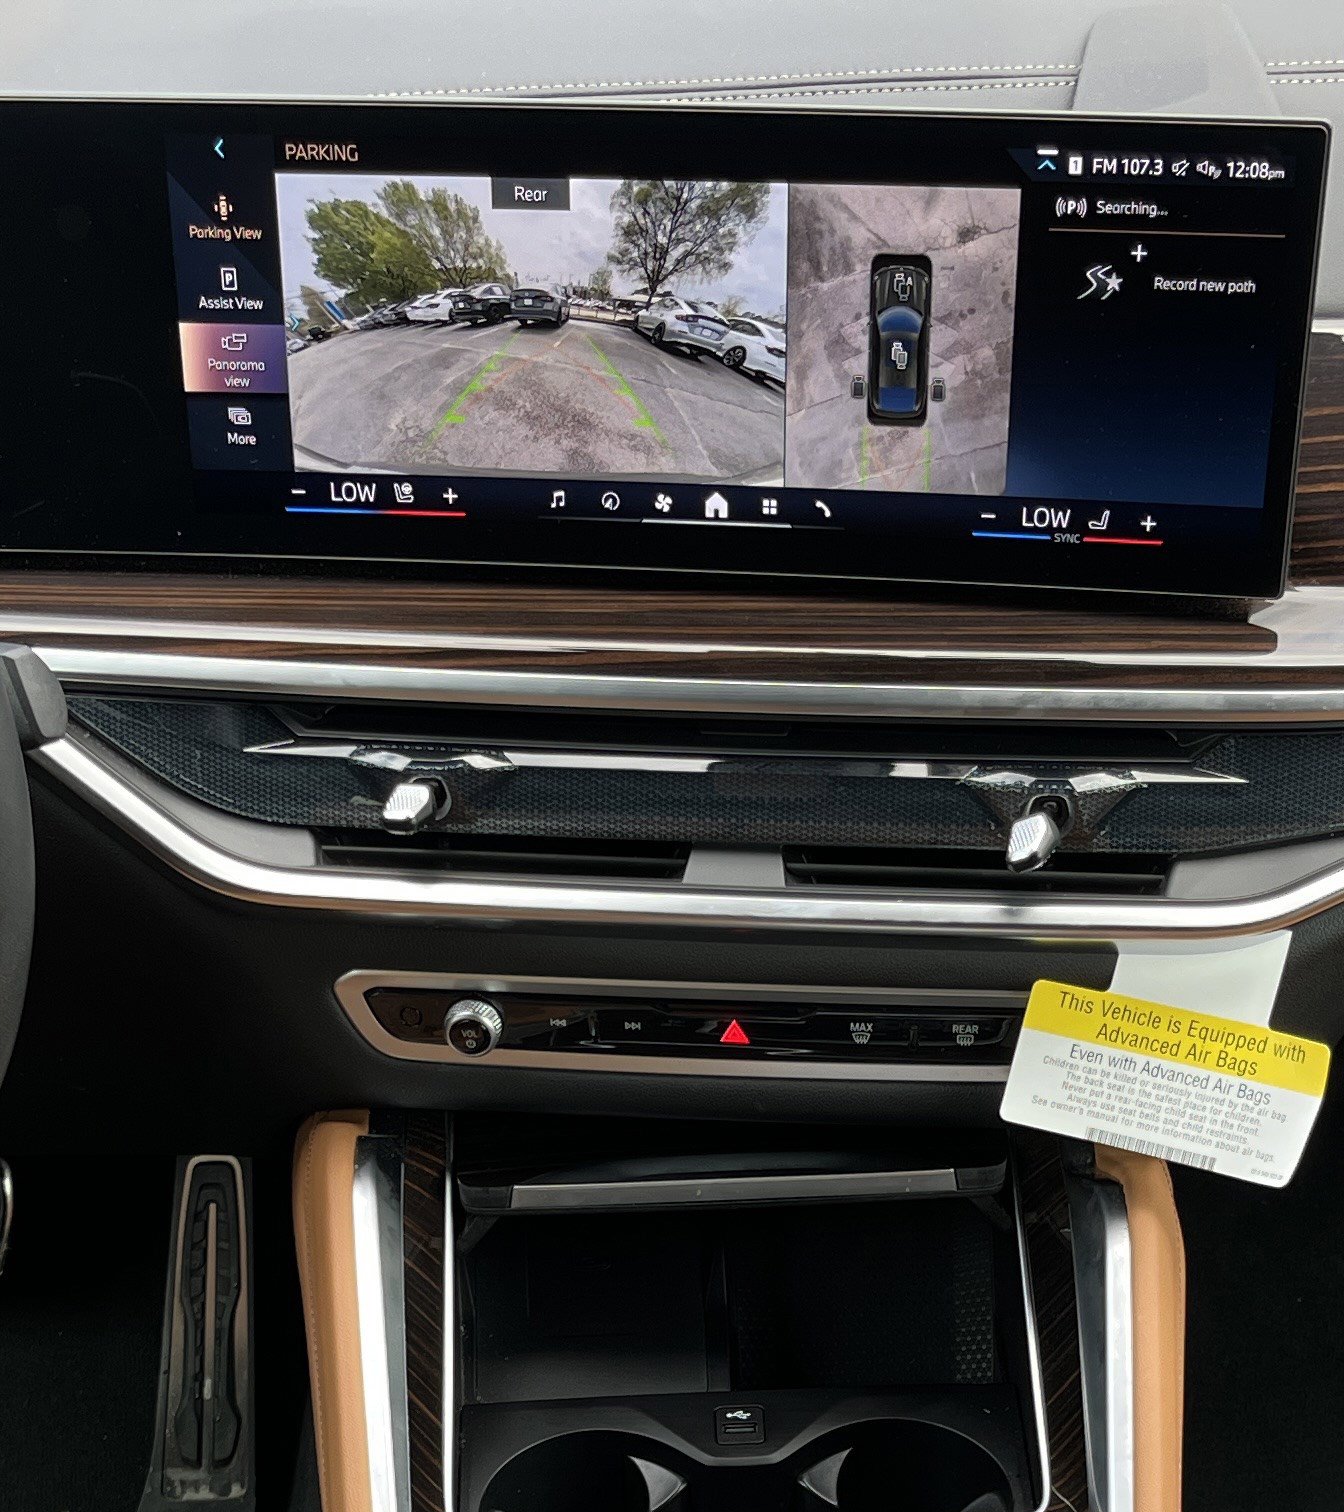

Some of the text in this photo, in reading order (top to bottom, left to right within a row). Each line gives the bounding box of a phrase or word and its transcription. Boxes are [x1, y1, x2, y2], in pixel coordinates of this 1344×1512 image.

[285, 144, 358, 162] PARKING
[1092, 159, 1118, 174] FM
[1121, 158, 1164, 176] 107.3
[514, 186, 548, 203] Rear
[188, 224, 262, 242] Parking View
[1154, 278, 1256, 294] Record new path
[198, 296, 264, 310] Assist View
[208, 358, 266, 372] Panorama
[224, 376, 250, 388] view
[227, 432, 256, 445] More
[330, 482, 376, 502] LOW
[1022, 507, 1070, 528] LOW
[1054, 533, 1080, 544] SYNC
[460, 1030, 478, 1038] VOL
[850, 1022, 873, 1032] MAX
[952, 1024, 979, 1034] REAR
[1060, 991, 1306, 1064] This Vehicle is Equipped with
[1096, 1023, 1258, 1076] Advanced Air Bags
[1070, 1044, 1272, 1106] Even with Advanced Air Bags
[1043, 1056, 1079, 1072] Children
[1082, 1066, 1098, 1076] can
[1100, 1068, 1110, 1078] be
[1114, 1072, 1138, 1084] killed
[1140, 1080, 1149, 1088] or
[1152, 1082, 1192, 1099] seriously
[1195, 1091, 1226, 1106] injured
[1228, 1100, 1238, 1111] by
[1241, 1102, 1254, 1113] the
[1257, 1108, 1268, 1116] air
[1066, 1071, 1081, 1081] The
[1084, 1076, 1104, 1088] back
[1107, 1082, 1125, 1092] seat
[1128, 1086, 1135, 1096] is
[1138, 1088, 1152, 1099] the
[1156, 1092, 1182, 1105] safest
[1183, 1100, 1207, 1112] place
[1210, 1107, 1222, 1116] for
[1061, 1081, 1086, 1094] Never
[1089, 1089, 1104, 1099] put
[1164, 1107, 1186, 1118] child
[1188, 1112, 1207, 1122] seat
[1210, 1117, 1218, 1125] in
[1220, 1119, 1234, 1129] the
[1067, 1093, 1097, 1108] Always
[1100, 1101, 1116, 1112] use
[1118, 1106, 1136, 1116] seat
[1139, 1110, 1160, 1122] belts
[1163, 1117, 1179, 1127] and
[1182, 1121, 1203, 1133] child
[1032, 1095, 1047, 1106] See
[1086, 1110, 1119, 1123] manual
[1121, 1117, 1134, 1126] for
[1136, 1121, 1160, 1132] more
[1162, 1126, 1212, 1146] information
[1214, 1141, 1240, 1154] about
[1242, 1147, 1254, 1156] air
